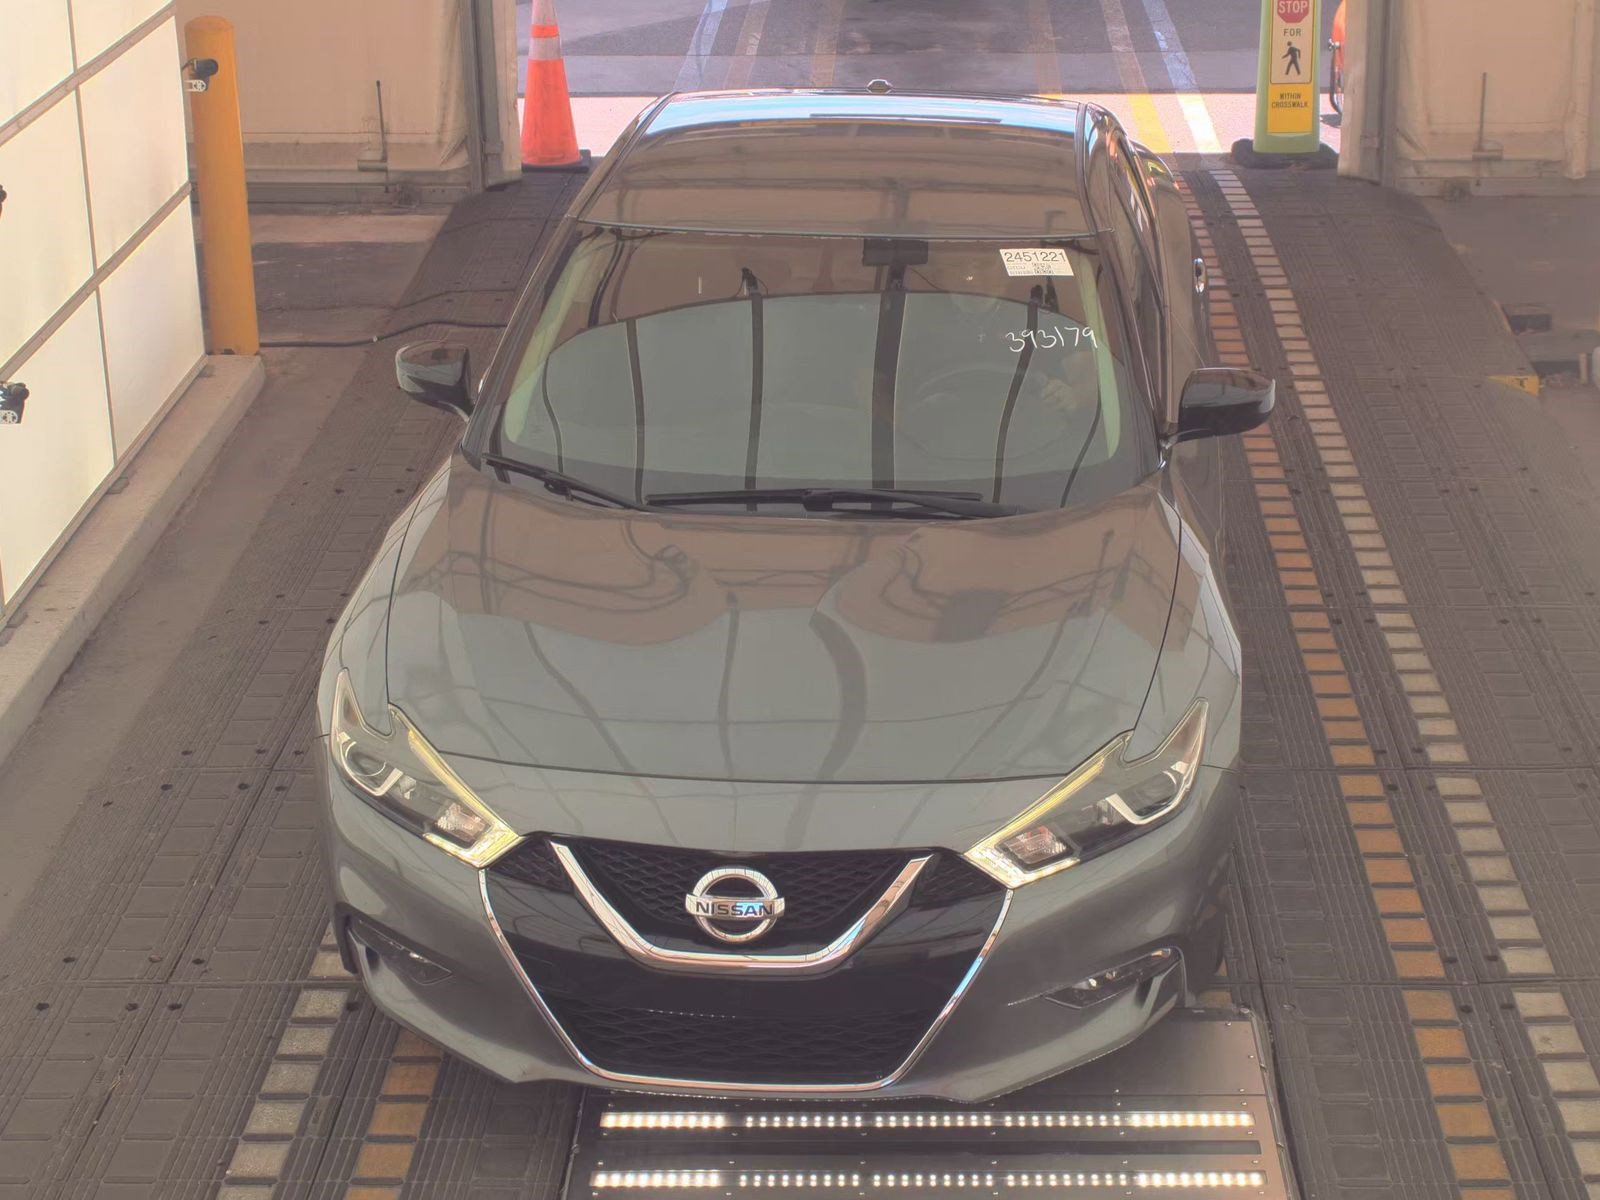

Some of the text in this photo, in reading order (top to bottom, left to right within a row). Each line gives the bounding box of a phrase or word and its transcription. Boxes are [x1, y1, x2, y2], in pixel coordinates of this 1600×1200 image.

[1278, 0, 1308, 14] STOP
[1283, 28, 1302, 37] FOR
[1279, 92, 1302, 100] WITHIN
[1271, 101, 1308, 109] CROSSWALK
[1004, 251, 1066, 262] 2451221
[1005, 326, 1098, 352] 393179
[696, 901, 773, 916] NISSAN
